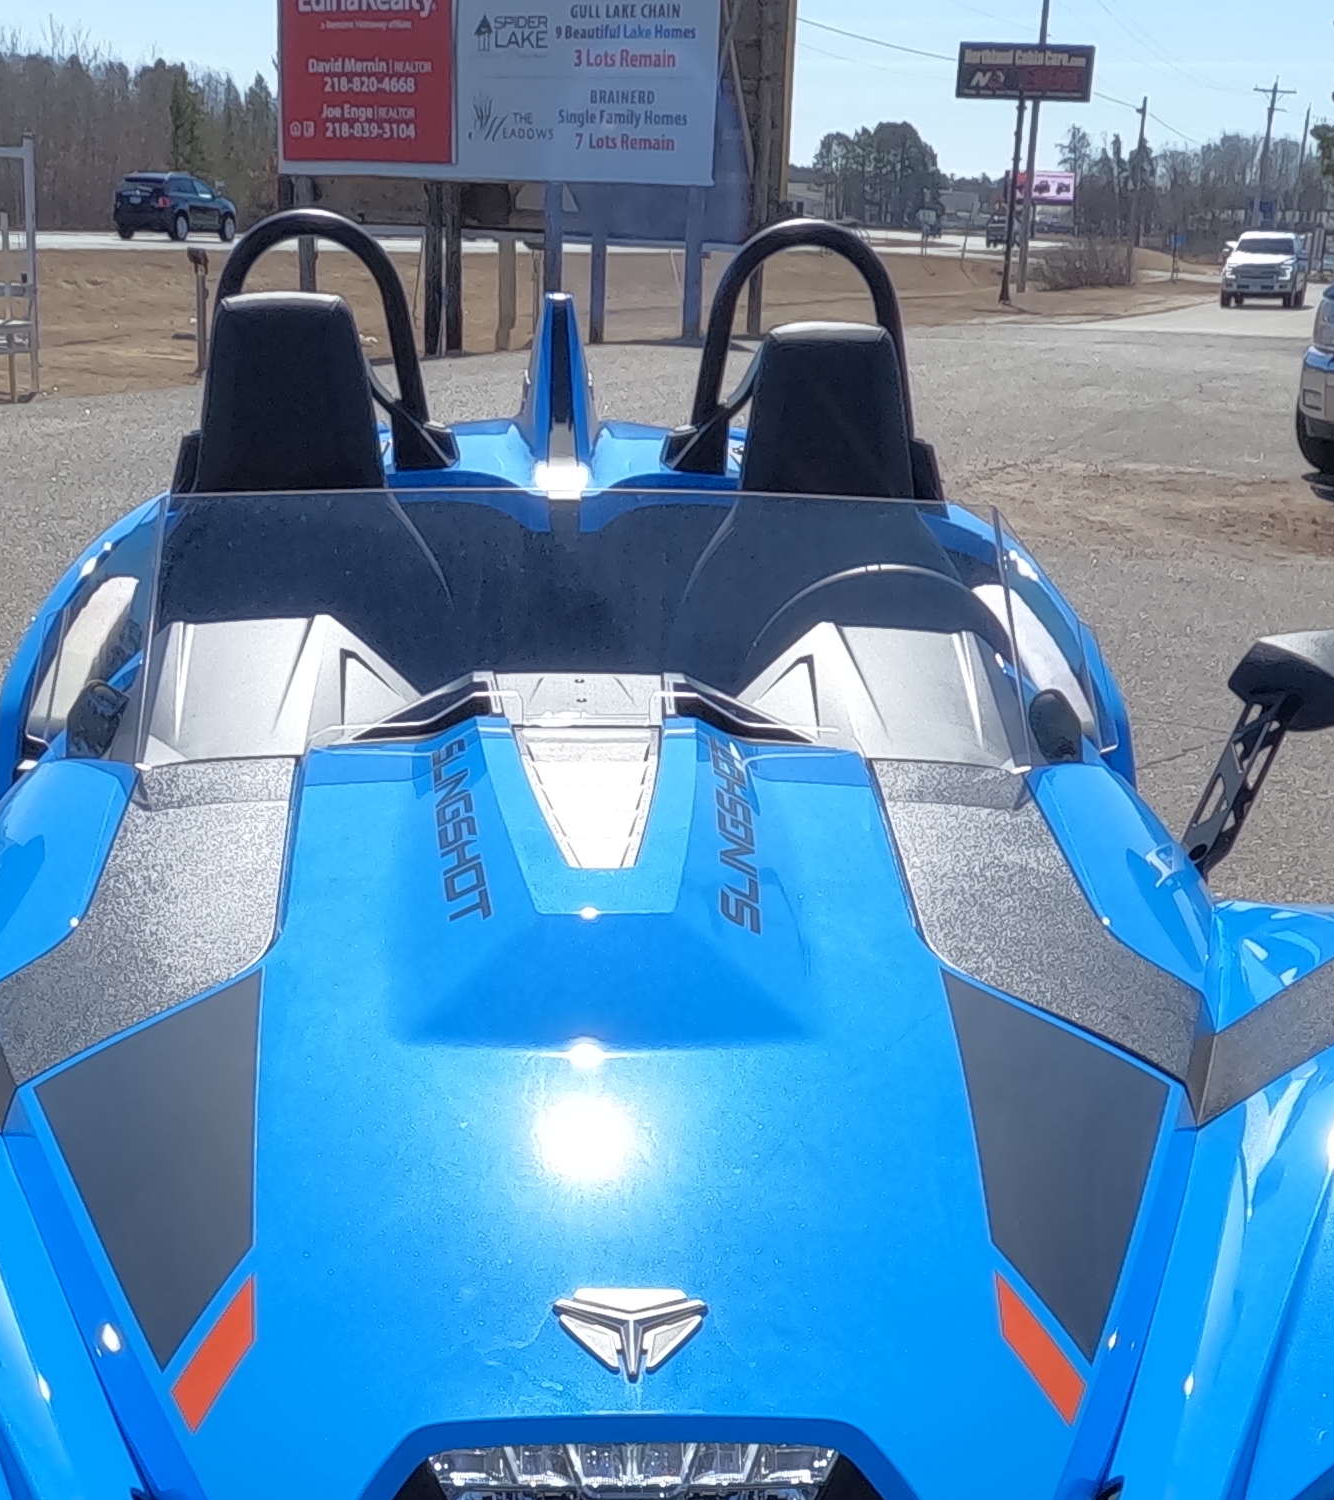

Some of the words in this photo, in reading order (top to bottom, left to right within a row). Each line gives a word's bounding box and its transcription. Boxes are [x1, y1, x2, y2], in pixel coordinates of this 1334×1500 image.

[570, 4, 601, 19] GULL
[606, 4, 637, 19] LAKE
[641, 3, 681, 19] CHAIN
[494, 15, 549, 30] SPIDER
[494, 30, 549, 49] LAKE
[555, 25, 563, 40] 9
[565, 24, 621, 39] Beautiful
[623, 24, 652, 39] Lake
[655, 24, 697, 40] Homes
[308, 57, 343, 74] David
[574, 49, 583, 68] 3
[586, 48, 616, 68] Lots
[620, 48, 677, 68] Remain
[323, 76, 416, 93] 218-820-4668
[590, 89, 655, 105] BRAINERD
[321, 103, 342, 119] Joe
[512, 112, 534, 125] THE
[558, 109, 597, 128] Single
[599, 109, 641, 129] Family
[644, 109, 688, 126] Homes
[324, 122, 417, 139] 218-839-3104
[575, 132, 584, 151] 7
[588, 133, 617, 150] Lots
[620, 133, 676, 151] Remain
[431, 737, 493, 923] SLINGSHOT
[708, 735, 763, 936] SLINGSHOT
